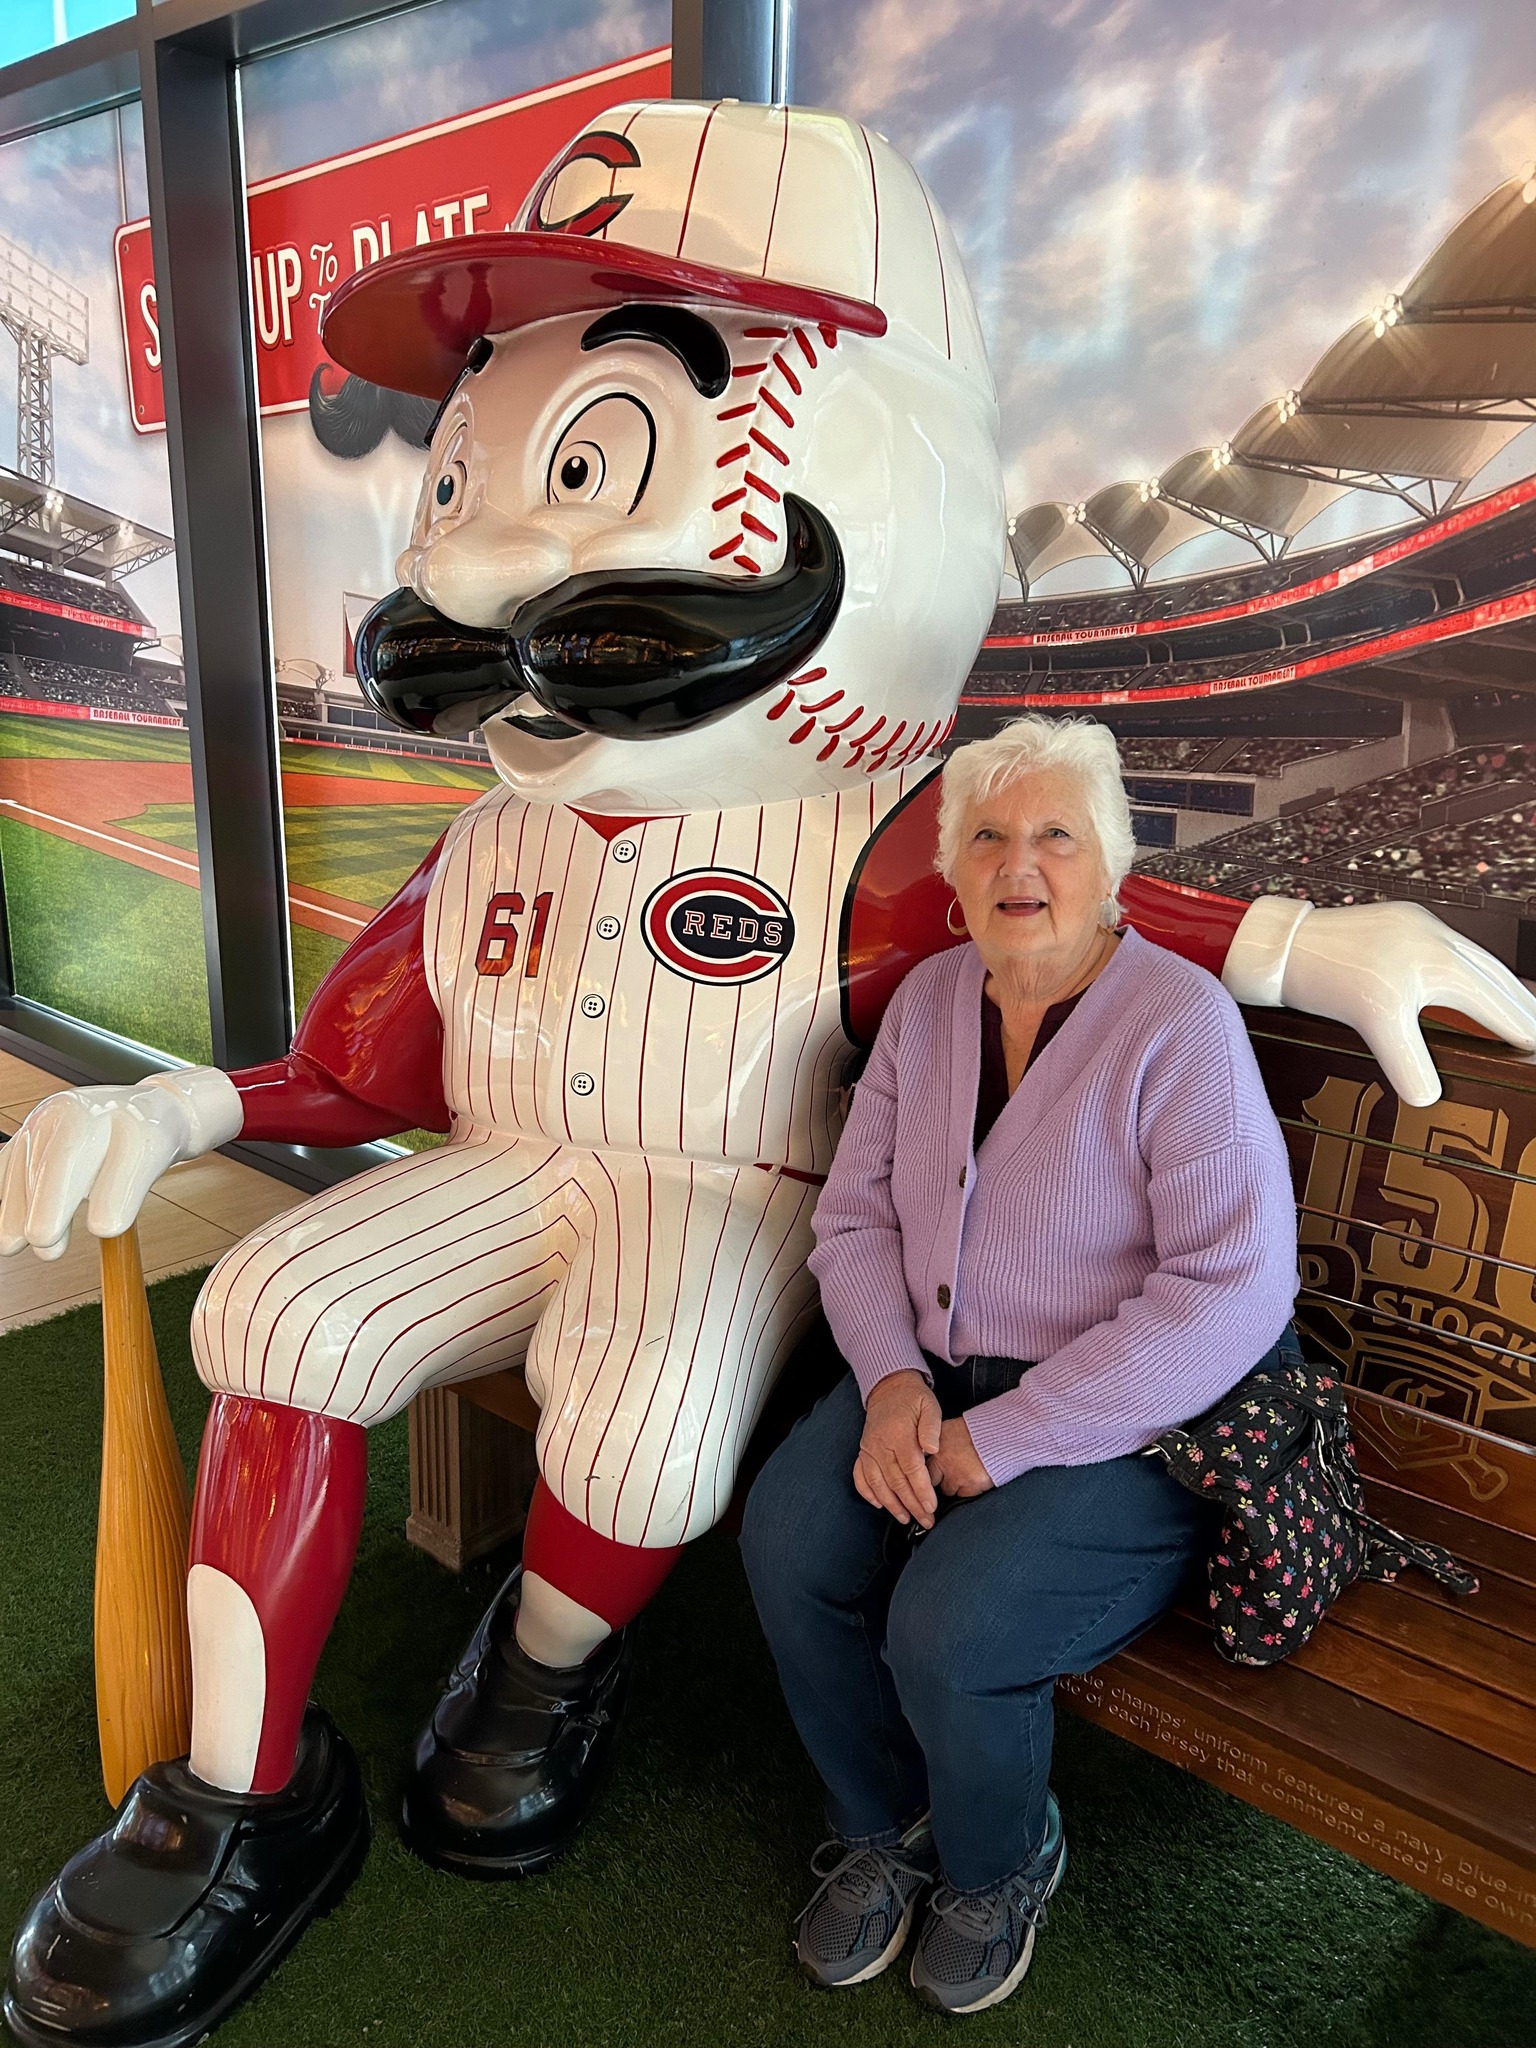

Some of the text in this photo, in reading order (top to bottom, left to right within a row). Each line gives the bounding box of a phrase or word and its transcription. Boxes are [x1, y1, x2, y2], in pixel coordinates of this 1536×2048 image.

[525, 128, 641, 237] C
[253, 247, 302, 345] UP
[1036, 625, 1135, 643] BASEBALL TOURNAMENT
[93, 709, 181, 727] BASEBALL TOURNAMENT
[1213, 678, 1247, 692] BASEBALL
[1248, 667, 1295, 687] TOURNAMENT
[475, 891, 554, 978] 61
[682, 909, 783, 946] REDS
[1086, 1693, 1104, 1707] of
[1109, 1704, 1151, 1733] each
[1155, 1724, 1210, 1763] jersey
[1217, 1756, 1255, 1786] that
[1262, 1782, 1429, 1874] commemorated
[1437, 1865, 1478, 1899] late
[1111, 1687, 1186, 1728] champs'
[1194, 1729, 1267, 1774] uniform
[1277, 1768, 1364, 1822] featured
[1373, 1818, 1386, 1833] a
[1396, 1829, 1446, 1864] navy
